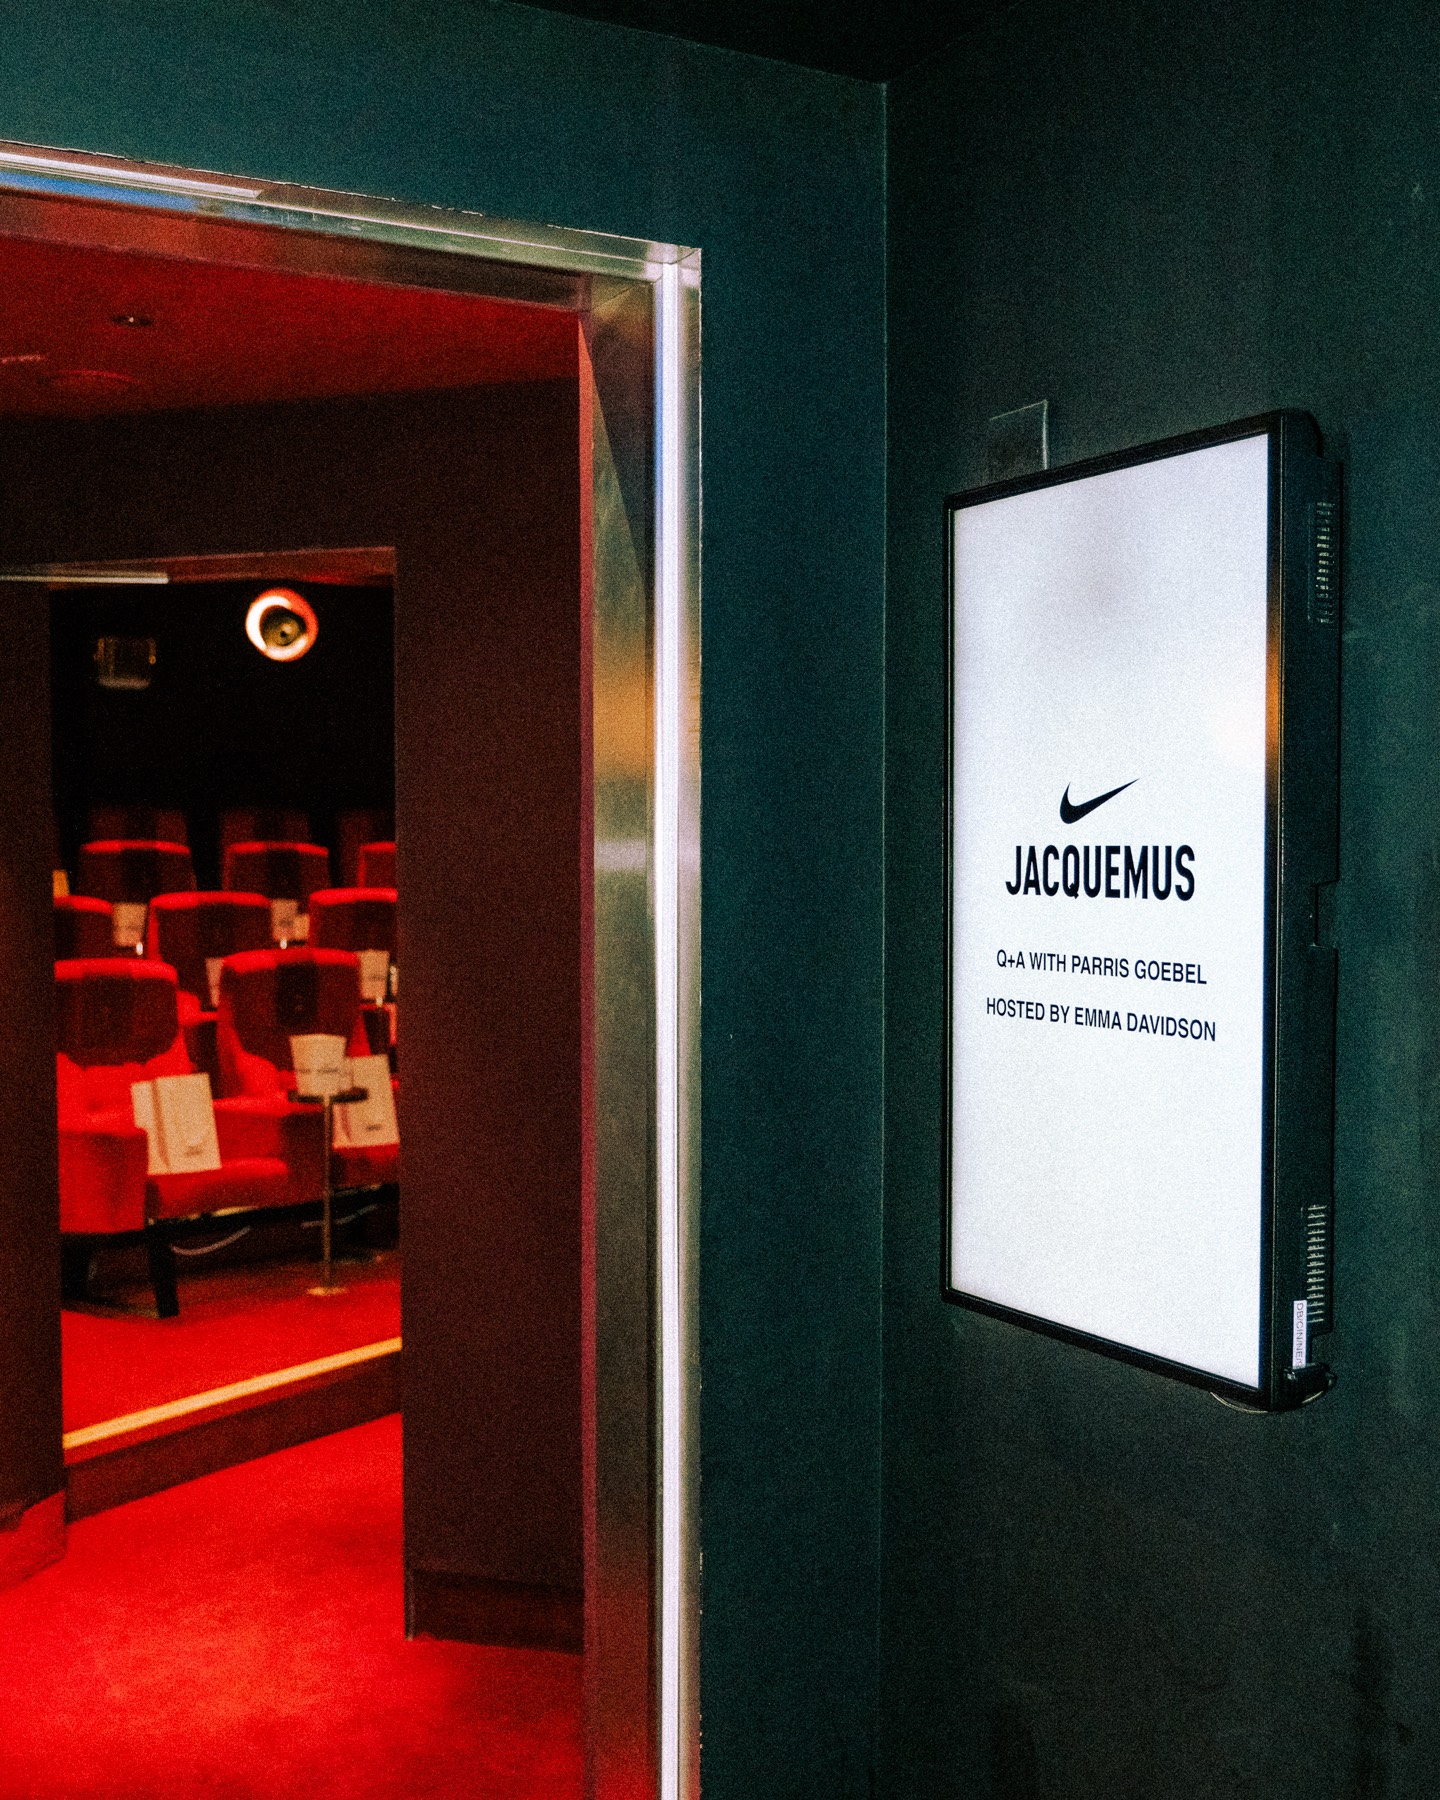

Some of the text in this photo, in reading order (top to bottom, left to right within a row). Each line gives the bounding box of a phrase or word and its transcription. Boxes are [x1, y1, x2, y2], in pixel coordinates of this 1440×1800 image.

[1005, 844, 1196, 902] JACQUEMUS
[996, 949, 1207, 985] Q+A WITH PARRIS GOEBEL
[986, 997, 1216, 1042] HOSTED BY EMMA DAVIDSON
